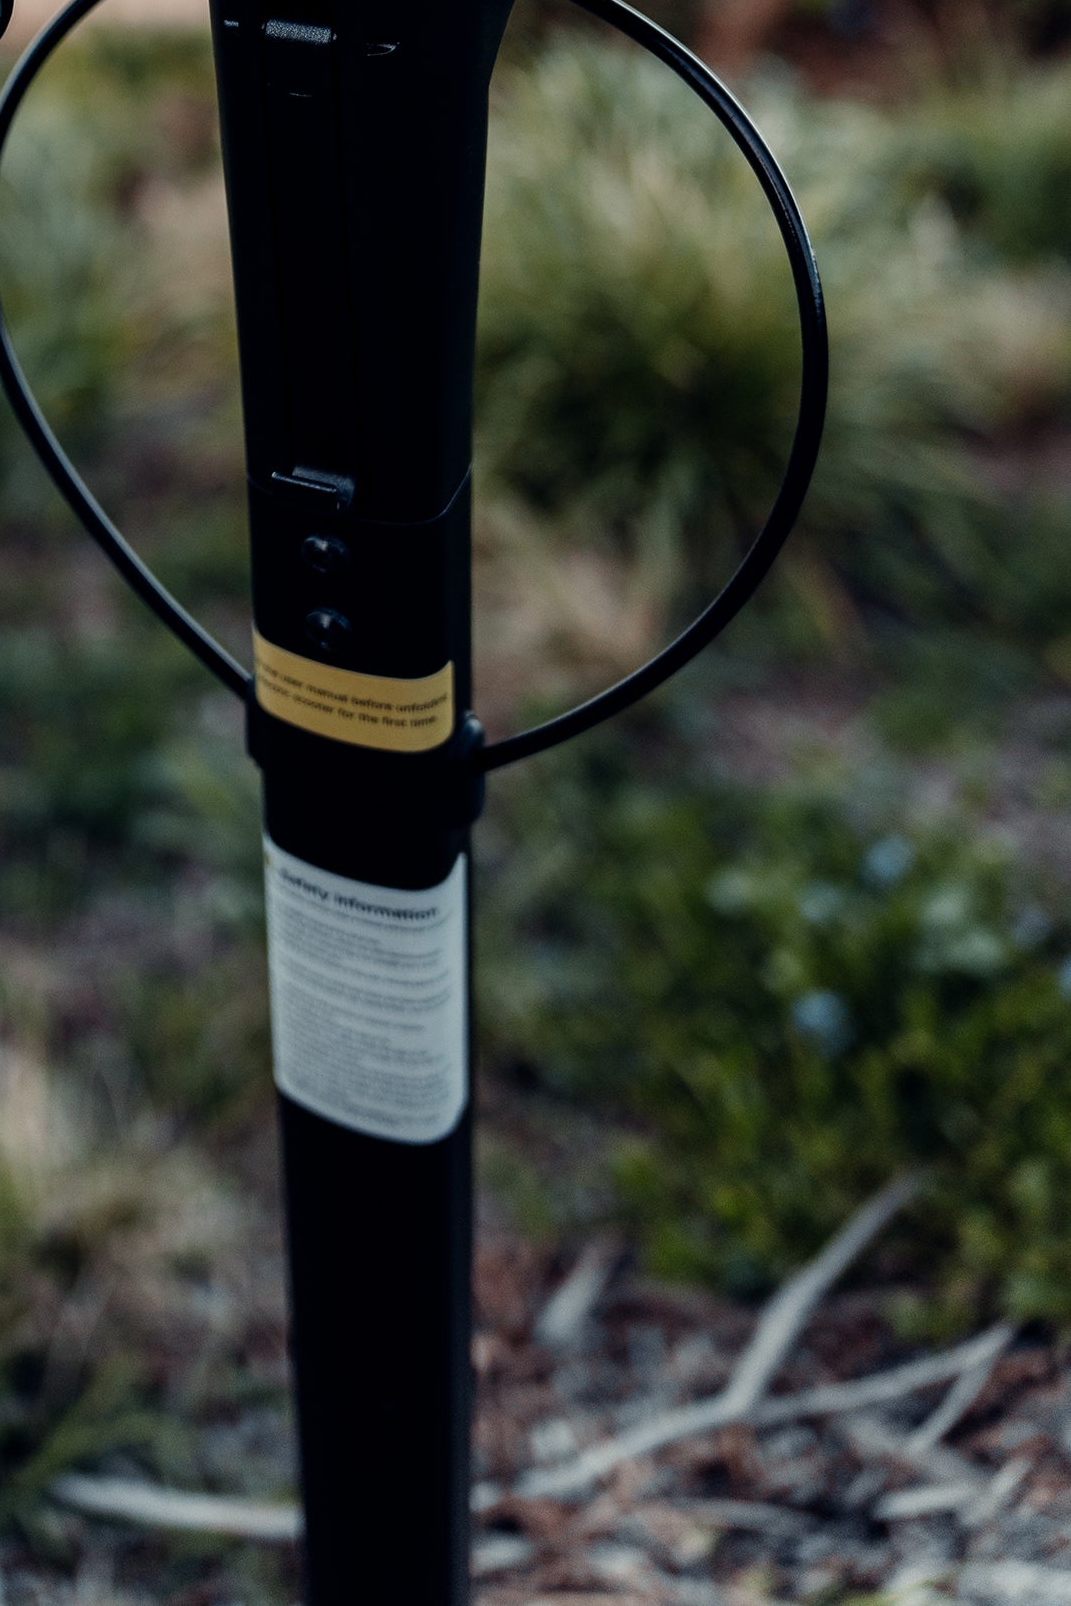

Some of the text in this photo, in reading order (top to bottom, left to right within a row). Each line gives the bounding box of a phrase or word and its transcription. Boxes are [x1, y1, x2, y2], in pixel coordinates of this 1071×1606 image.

[306, 683, 349, 703] manual
[351, 696, 394, 712] before
[337, 707, 354, 719] for
[382, 715, 408, 728] first
[334, 892, 438, 921] information
